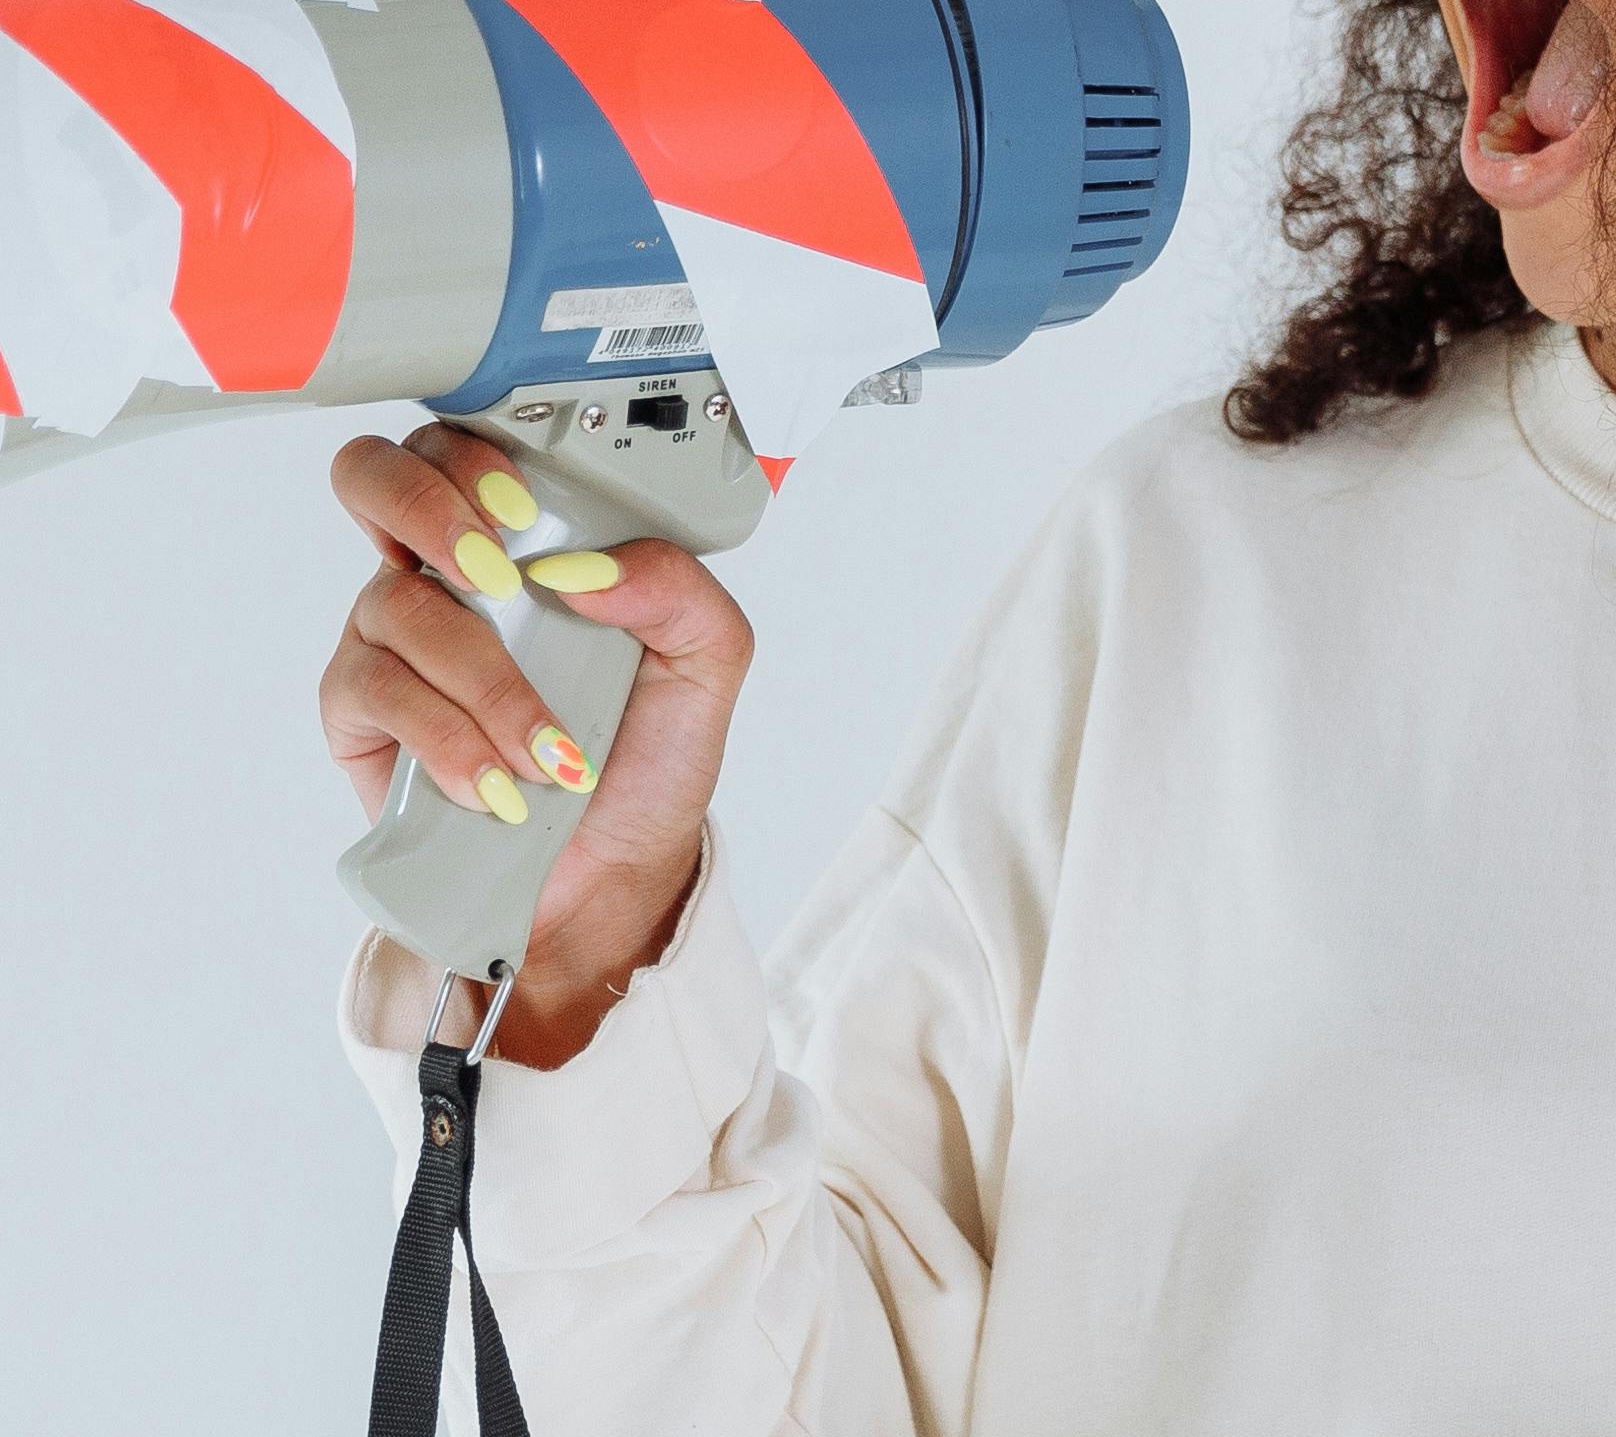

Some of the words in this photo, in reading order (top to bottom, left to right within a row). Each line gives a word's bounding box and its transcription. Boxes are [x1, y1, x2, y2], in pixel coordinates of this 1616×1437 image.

[638, 378, 677, 393] SIREN
[614, 437, 632, 450] ON
[672, 430, 697, 444] OFF
